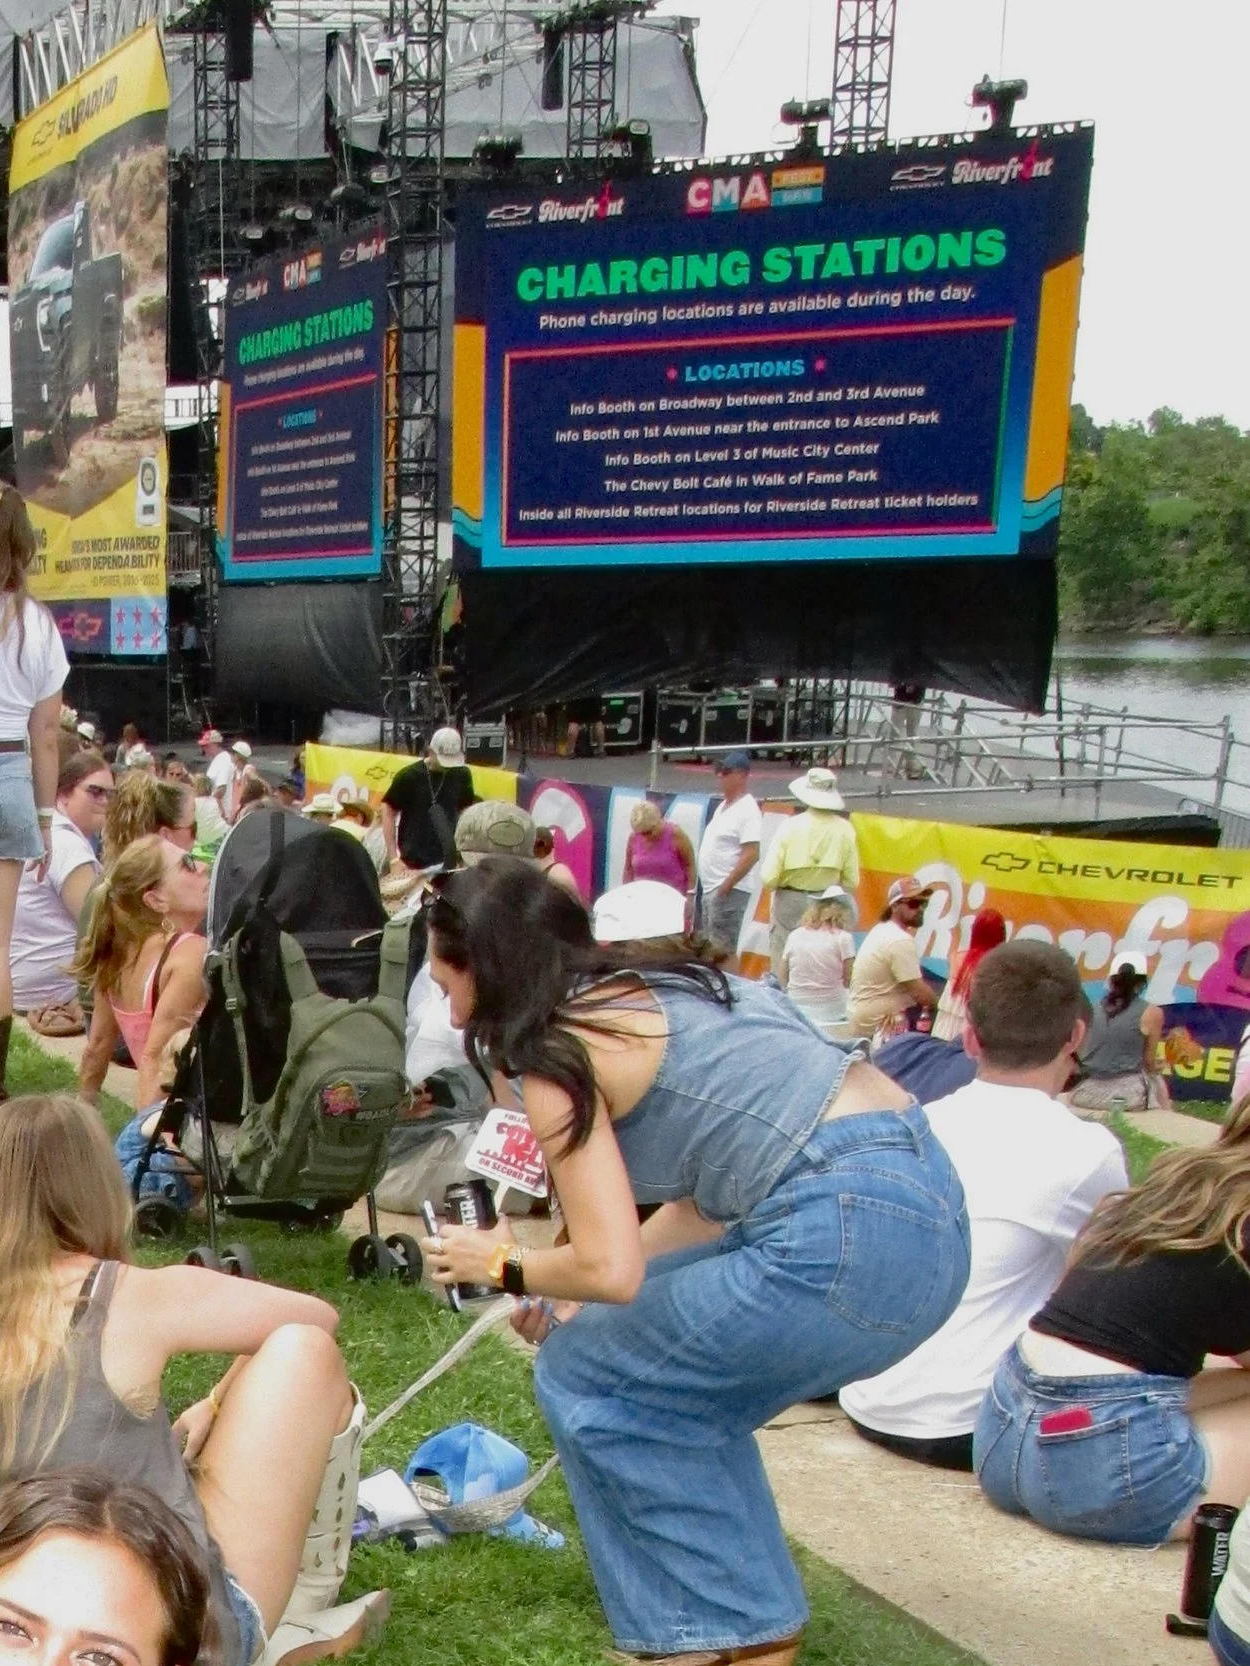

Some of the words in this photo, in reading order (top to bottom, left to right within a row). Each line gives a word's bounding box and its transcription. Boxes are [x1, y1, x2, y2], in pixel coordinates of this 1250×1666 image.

[687, 172, 770, 209] CMA
[517, 251, 750, 302] CHARGING
[762, 229, 1006, 283] STATIONS
[540, 315, 585, 330] Phone
[590, 308, 657, 327] charging
[663, 304, 734, 321] locations
[738, 302, 764, 315] are
[768, 296, 841, 314] available
[847, 290, 901, 308] during
[907, 287, 935, 303] the
[940, 284, 975, 303] day.
[239, 321, 301, 365] CHARGING
[304, 299, 374, 347] STATIONS
[685, 359, 805, 382] LOCATIONS
[570, 403, 594, 416] Info
[598, 399, 635, 414] Booth
[639, 400, 655, 412] on
[659, 396, 723, 411] Broadway
[726, 393, 783, 407] between
[787, 391, 813, 404] 2nd
[817, 389, 842, 402] and
[846, 387, 869, 400] 3rd
[873, 386, 925, 399] Avenue
[555, 430, 579, 443] Info
[582, 427, 620, 441] Booth
[623, 429, 639, 440] on
[643, 426, 659, 438] 1st
[663, 424, 711, 437] Avenue
[714, 423, 743, 435] near
[747, 420, 768, 432] the
[772, 419, 830, 431] entrance
[835, 417, 849, 429] to
[853, 413, 904, 427] Ascend
[908, 411, 940, 424] Park
[605, 455, 629, 467] Info
[633, 451, 671, 466] Booth
[675, 453, 691, 464] on
[695, 450, 728, 463] Level
[733, 449, 741, 461] 3
[744, 448, 758, 460] of
[762, 445, 799, 459] Music
[803, 444, 830, 459] City
[834, 442, 880, 456] Center
[605, 480, 627, 493] The
[631, 479, 669, 494] Chevy
[673, 477, 700, 490] Bolt
[703, 475, 732, 489] Café
[752, 473, 784, 486] Walk
[788, 472, 803, 485] of
[806, 471, 843, 484] Fame
[848, 469, 878, 482] Park
[519, 508, 554, 521] Inside
[557, 507, 572, 519] all
[575, 504, 630, 519] Riverside
[634, 503, 679, 517] Retreat
[682, 500, 740, 516] locations
[744, 500, 762, 513] for
[766, 498, 826, 513] Riverside
[831, 497, 880, 510] Retreat
[884, 495, 923, 508] ticket
[926, 493, 978, 506] holders
[112, 535, 160, 551] AWARDED
[92, 553, 160, 570] DEPENDABILITY
[1038, 861, 1242, 889] CHEVROLET
[491, 1159, 524, 1182] SECOND
[1211, 1531, 1230, 1577] WATER
